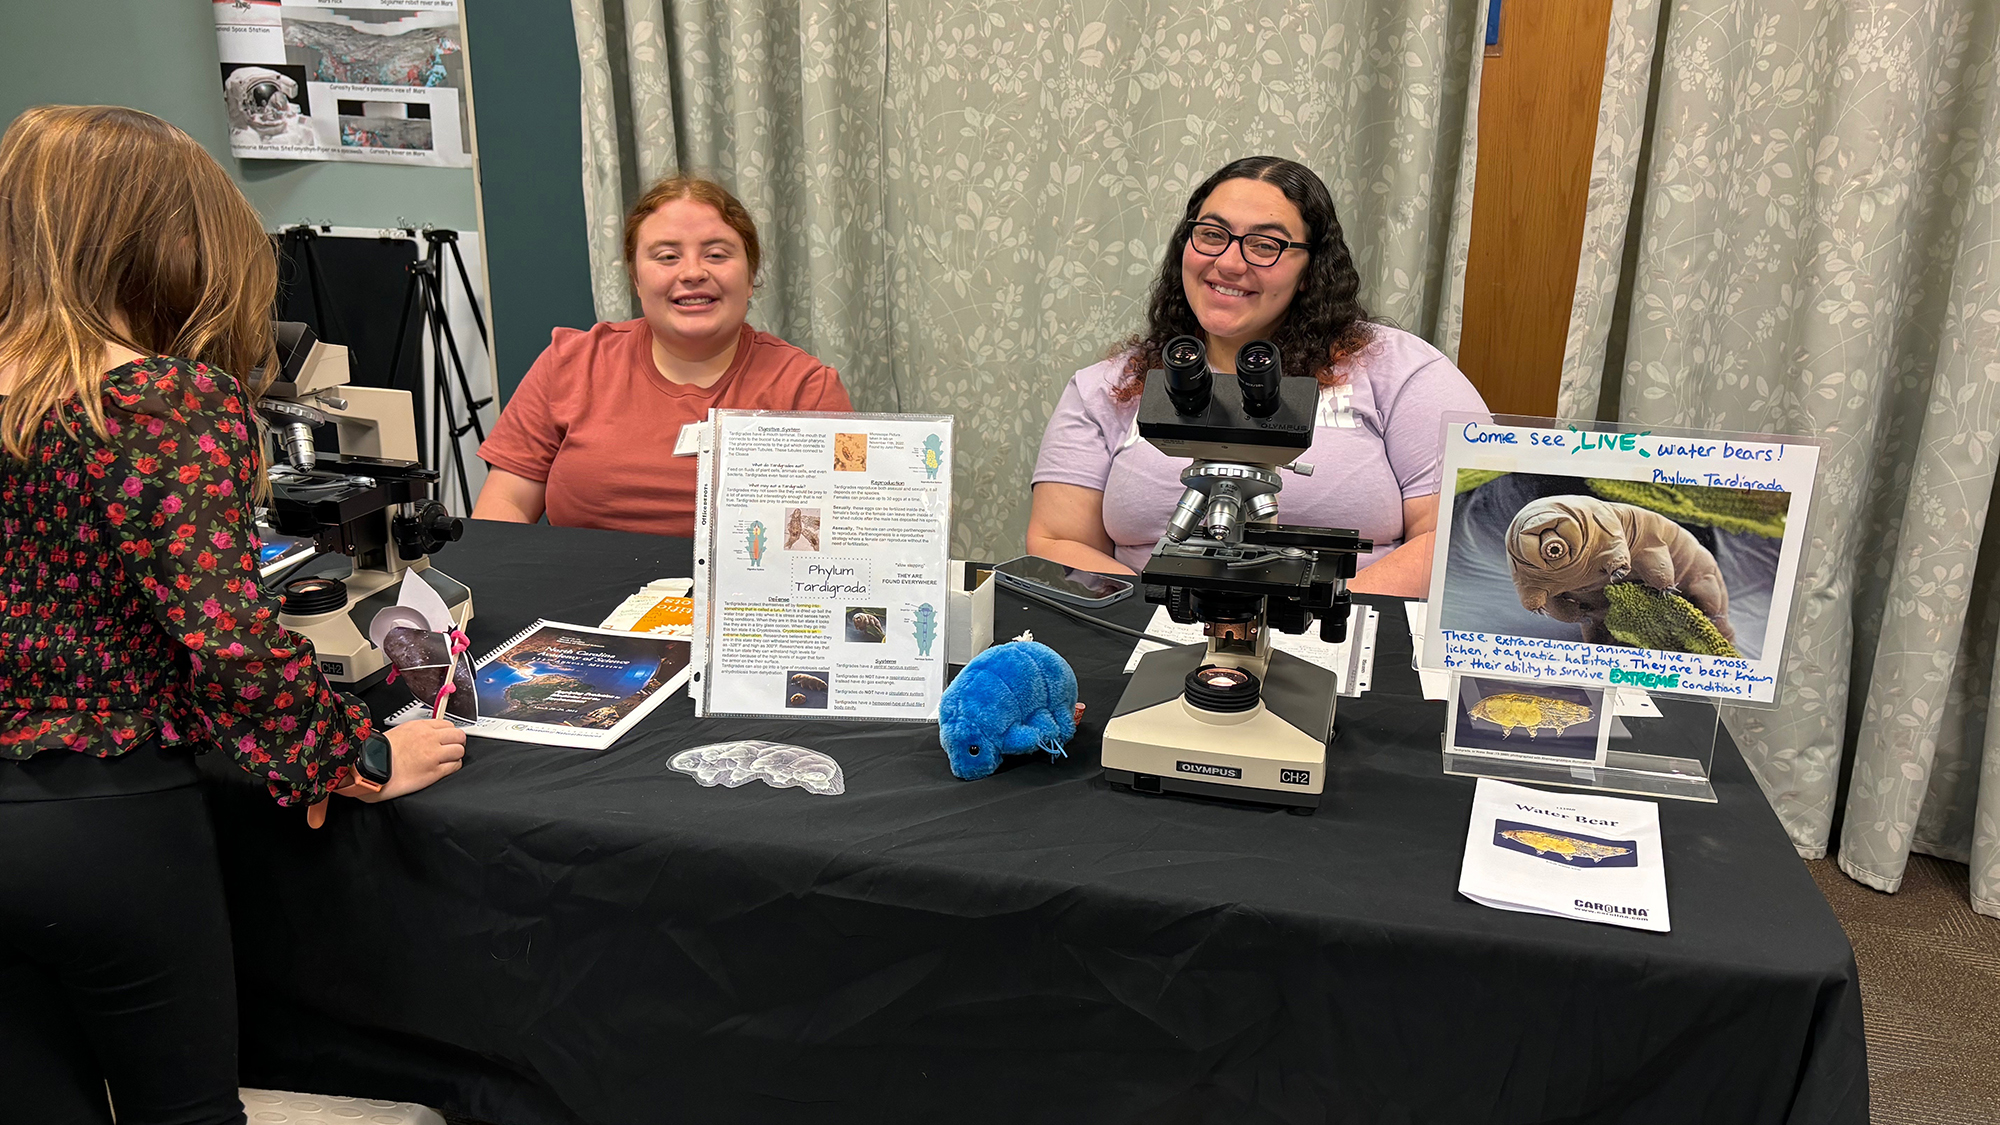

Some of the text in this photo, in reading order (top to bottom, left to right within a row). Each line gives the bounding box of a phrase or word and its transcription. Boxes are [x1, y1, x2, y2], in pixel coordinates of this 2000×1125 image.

[1260, 422, 1308, 430] OLYMPUS
[1463, 422, 1784, 462] Come see LIVE water bears!
[1652, 469, 1787, 493] Phylum Tardigrada
[808, 564, 854, 582] Phylum
[795, 582, 867, 598] Tardigrada
[545, 646, 616, 659] North Carolina
[1442, 630, 1486, 645] These
[1495, 635, 1592, 658] extraordinary
[1596, 642, 1652, 660] animals
[1660, 652, 1684, 664] live
[1689, 654, 1702, 664] in
[537, 651, 582, 661] Academy
[594, 656, 630, 665] Science
[1505, 648, 1557, 665] aquatic
[1631, 658, 1666, 676] They
[1669, 663, 1692, 674] are
[1700, 665, 1730, 679] best
[322, 662, 342, 674] CH-2
[1444, 656, 1466, 669] for
[1470, 657, 1502, 671] their
[1504, 660, 1542, 680] ability
[1545, 664, 1559, 677] to
[1560, 666, 1604, 682] survive
[1608, 668, 1682, 690] EXTREME
[1181, 763, 1308, 784] OLYMPUS CH-2
[1516, 803, 1620, 827] Water Bear
[1574, 899, 1648, 917] CAROLINA
